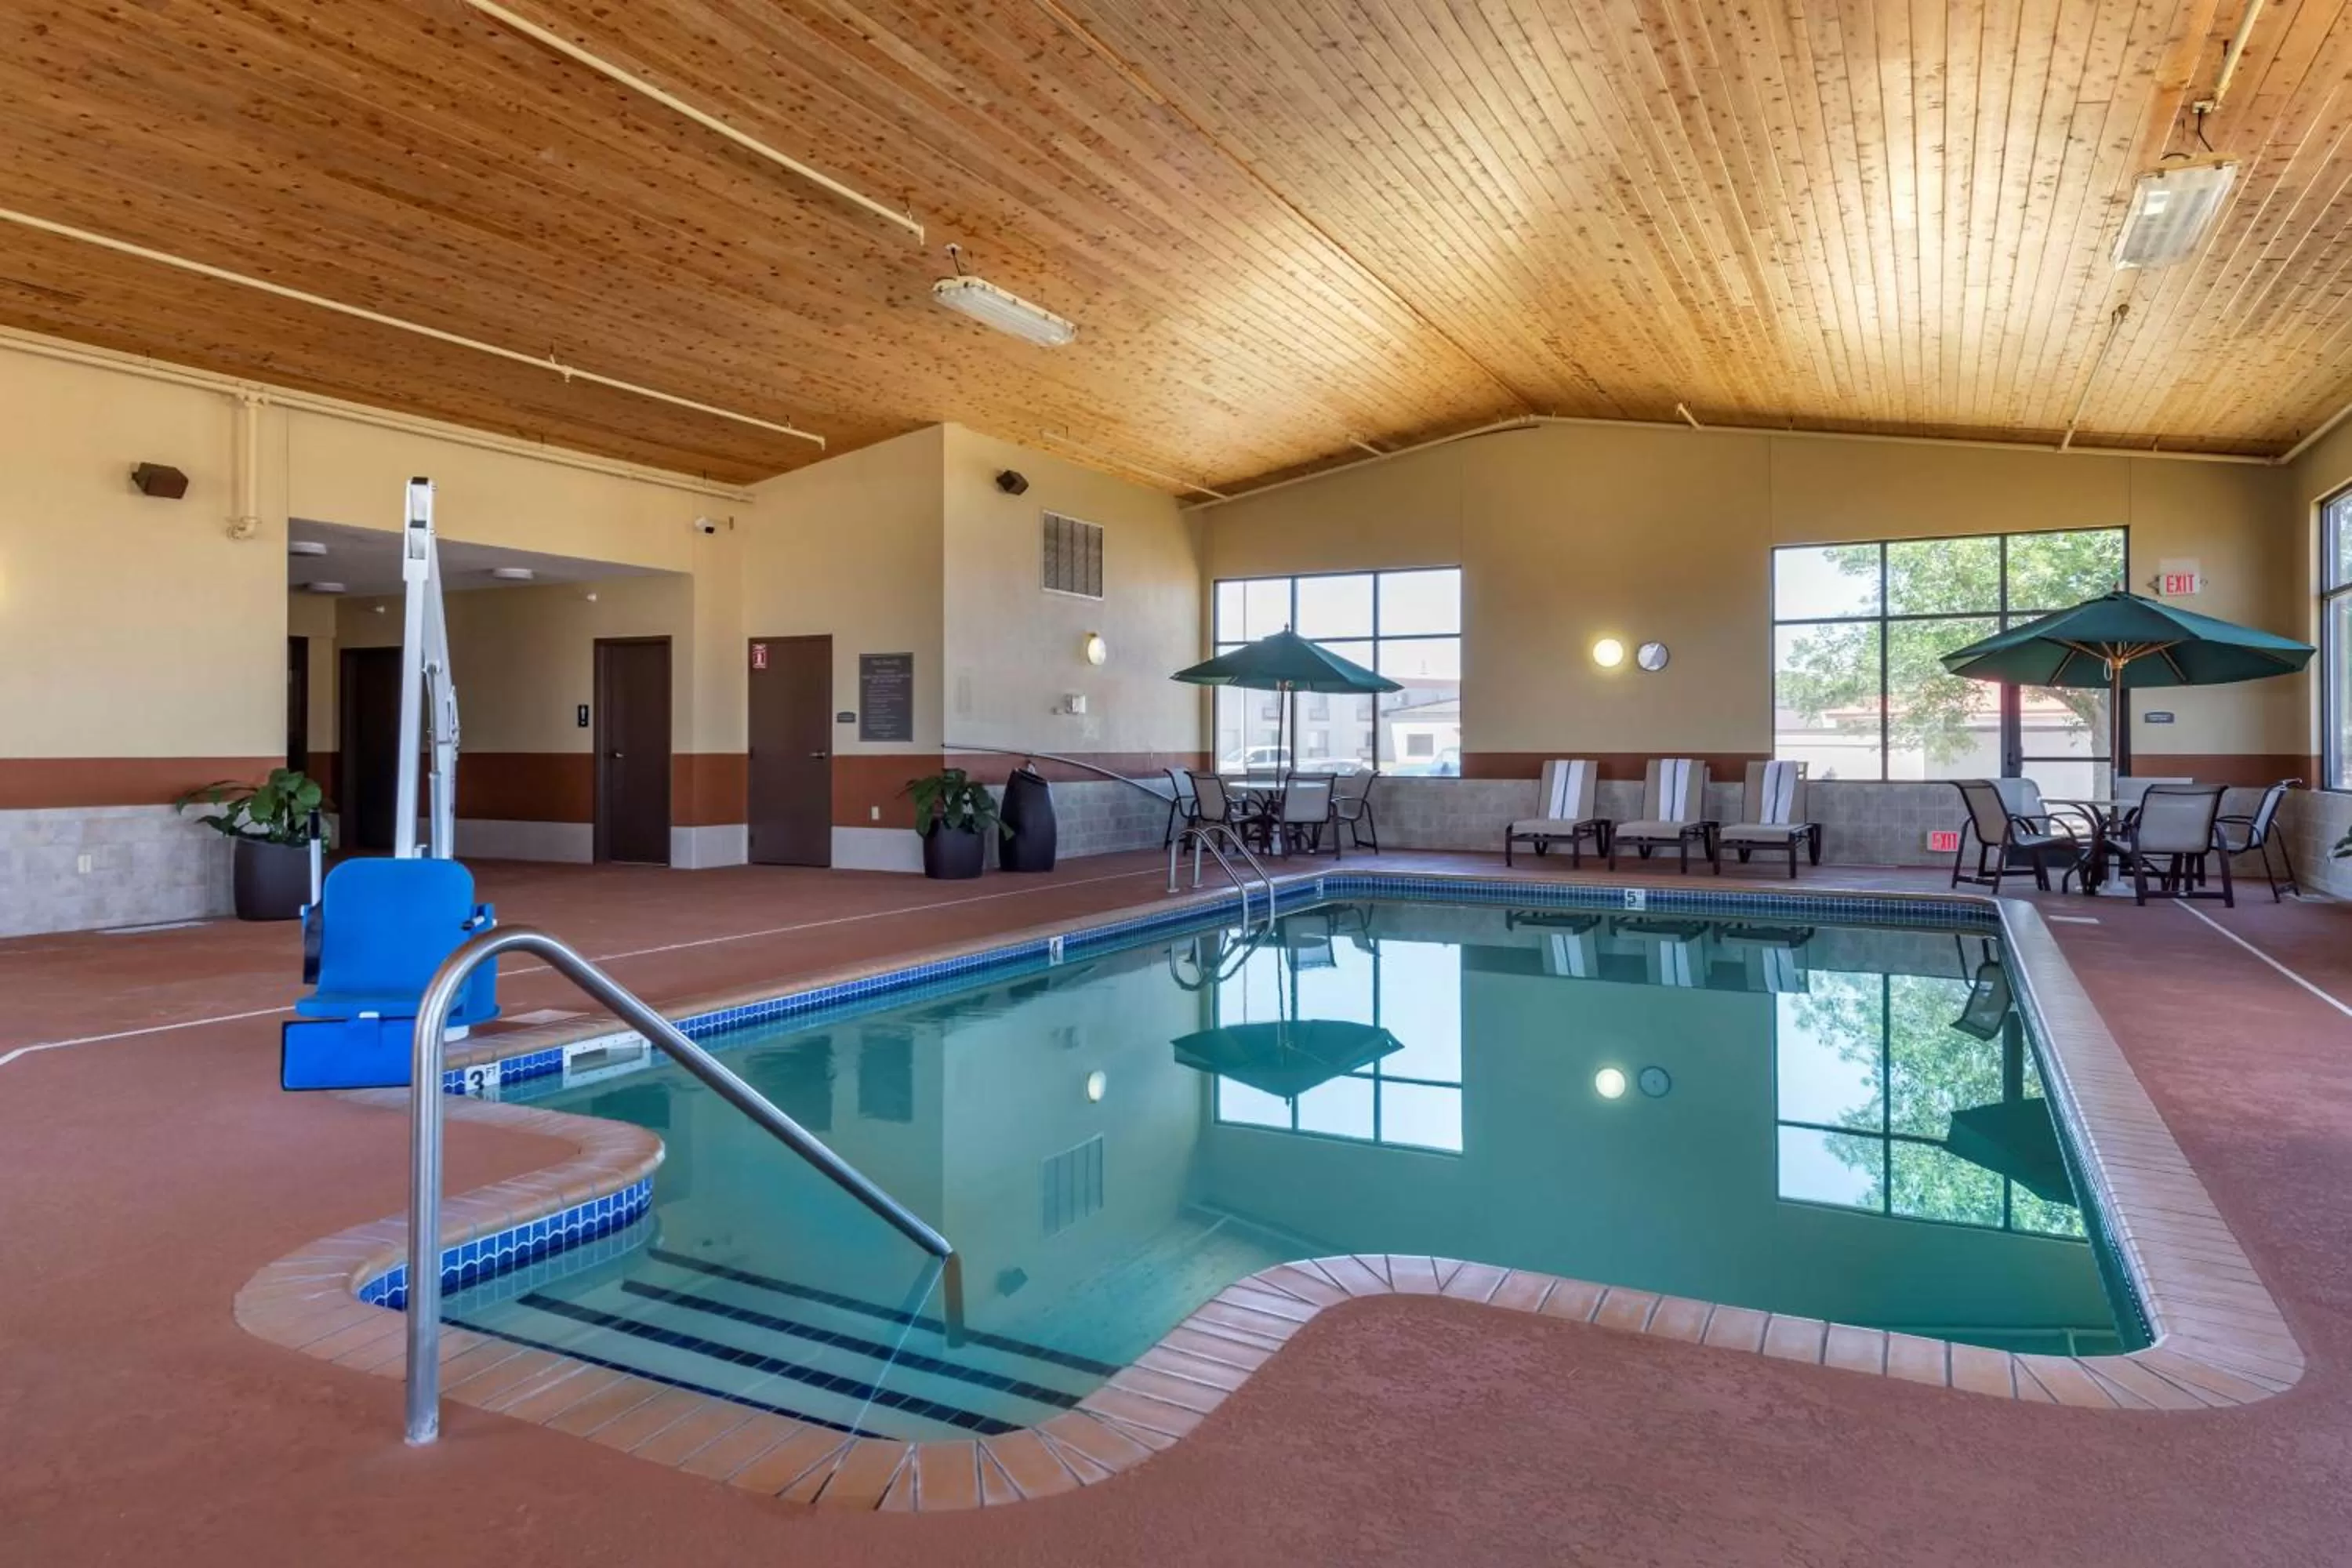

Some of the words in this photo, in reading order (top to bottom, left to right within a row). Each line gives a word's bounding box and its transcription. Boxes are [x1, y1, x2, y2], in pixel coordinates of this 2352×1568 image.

[2166, 574, 2194, 593] EXIT
[1932, 832, 1958, 851] EXIT
[470, 1070, 484, 1090] 3
